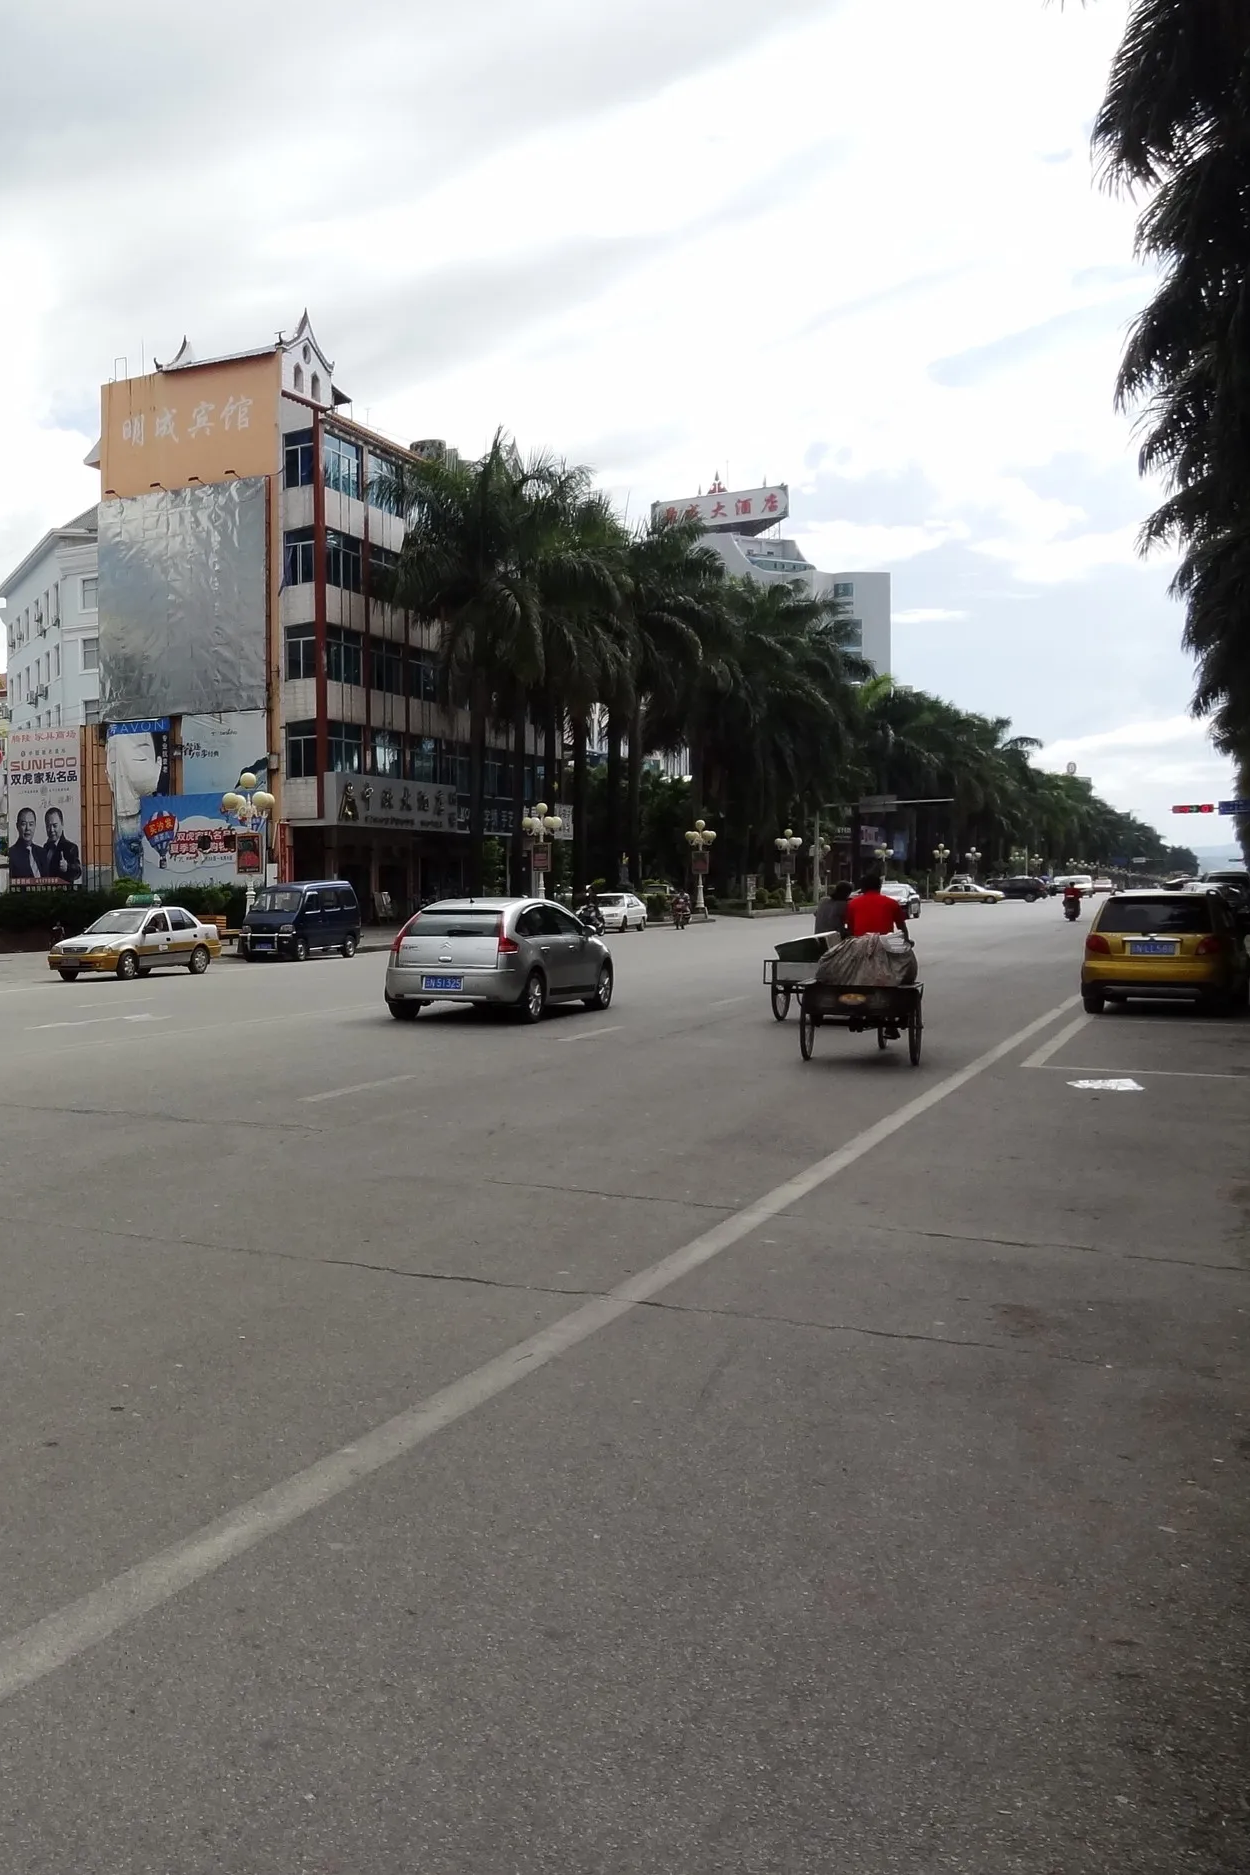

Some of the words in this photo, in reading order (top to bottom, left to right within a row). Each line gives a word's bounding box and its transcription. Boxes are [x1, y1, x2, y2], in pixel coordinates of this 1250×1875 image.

[120, 719, 165, 734] AVON
[10, 756, 77, 772] SUNHOO
[10, 770, 78, 786] 双虎家私名品
